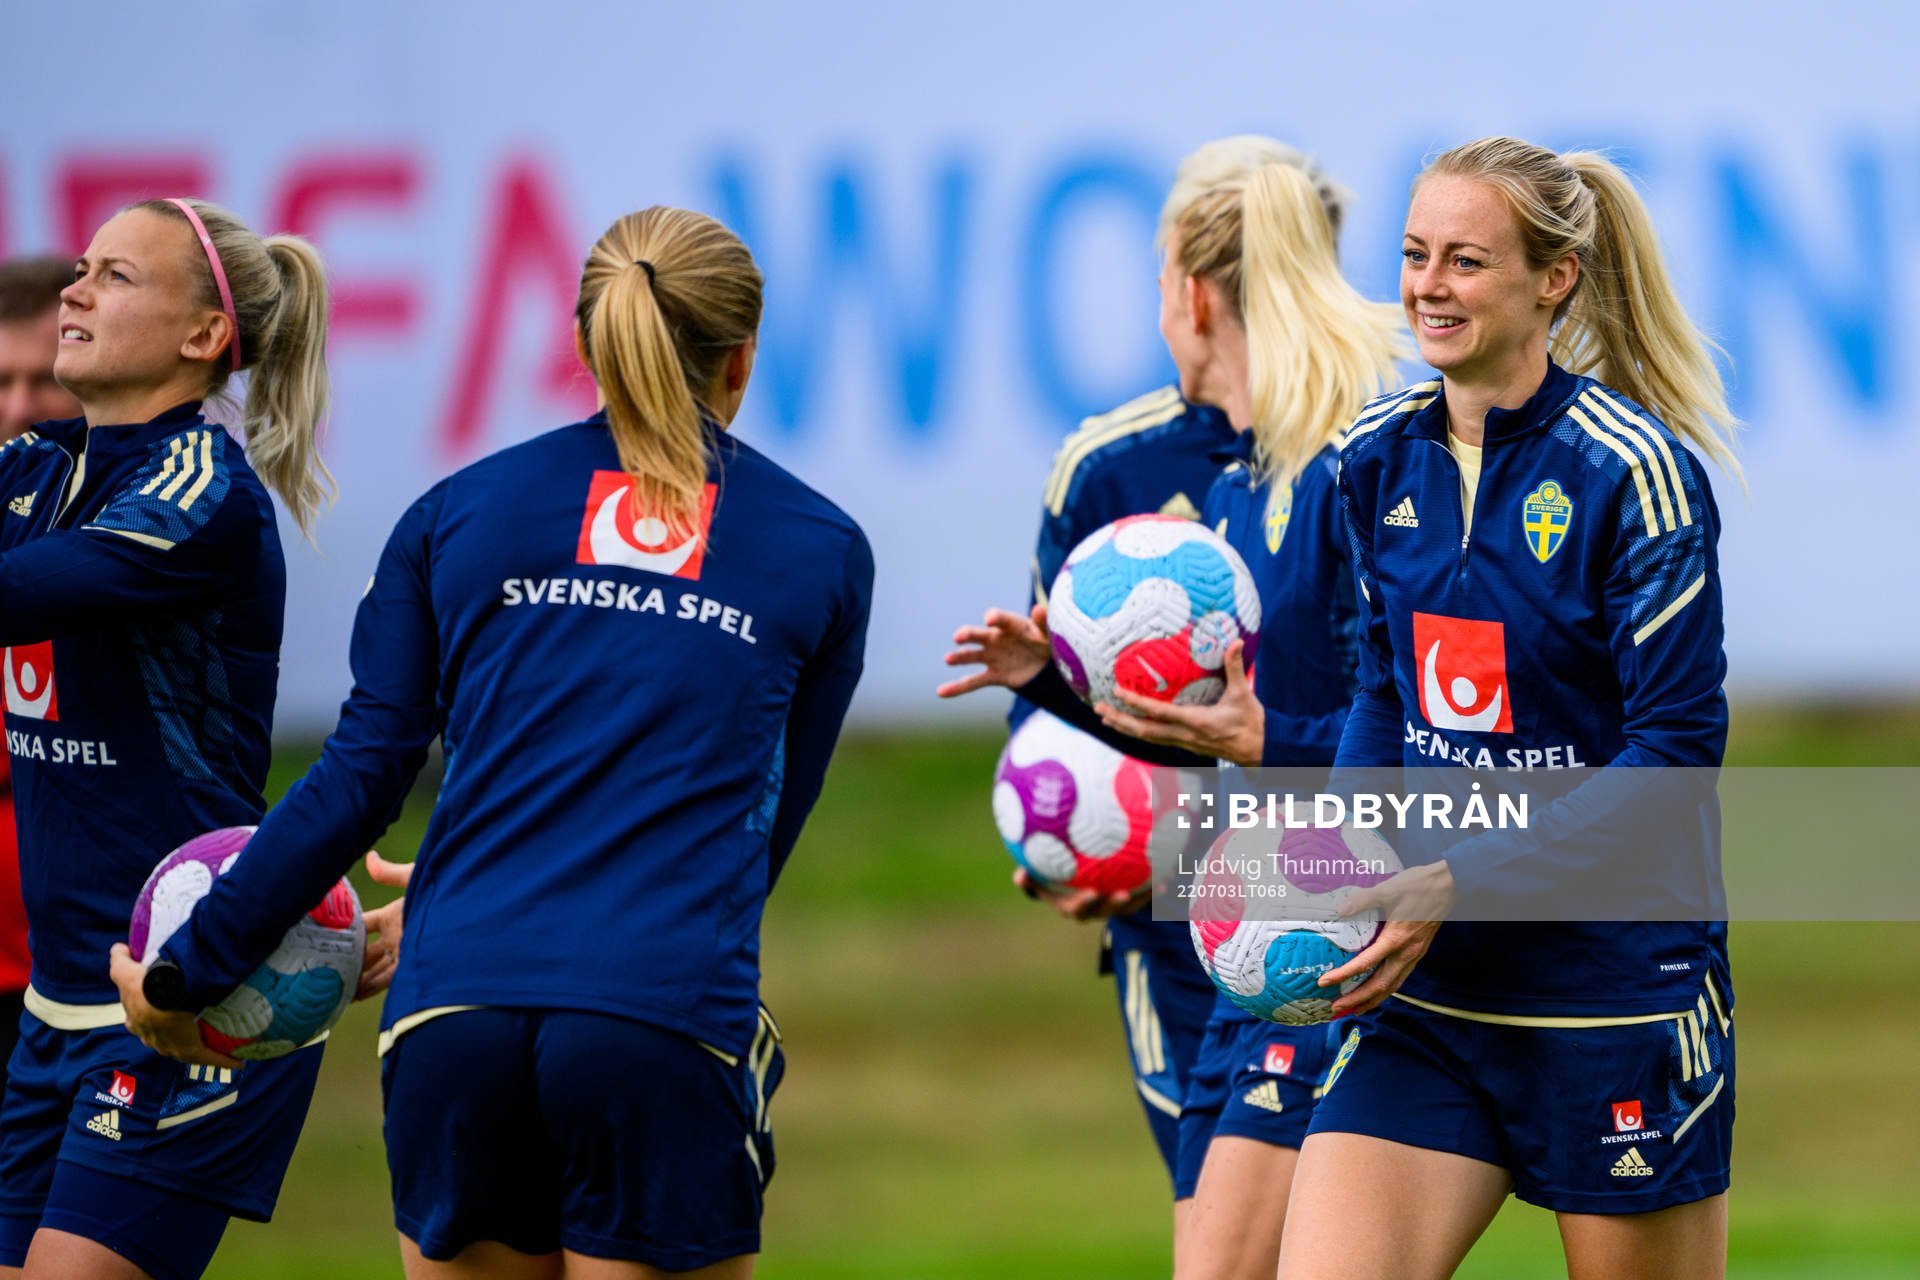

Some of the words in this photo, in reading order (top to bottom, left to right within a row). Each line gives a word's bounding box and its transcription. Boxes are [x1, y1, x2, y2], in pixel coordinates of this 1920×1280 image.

[1383, 515, 1419, 528] adidas
[502, 578, 666, 615] SVENSKA
[676, 593, 757, 644] SPEL
[52, 738, 117, 765] SPEL
[1506, 745, 1585, 772] SPEL
[86, 1120, 122, 1141] adidas
[1601, 1133, 1640, 1144] SVENSKA
[1641, 1130, 1663, 1140] SPEL
[1610, 1166, 1654, 1177] adidas
